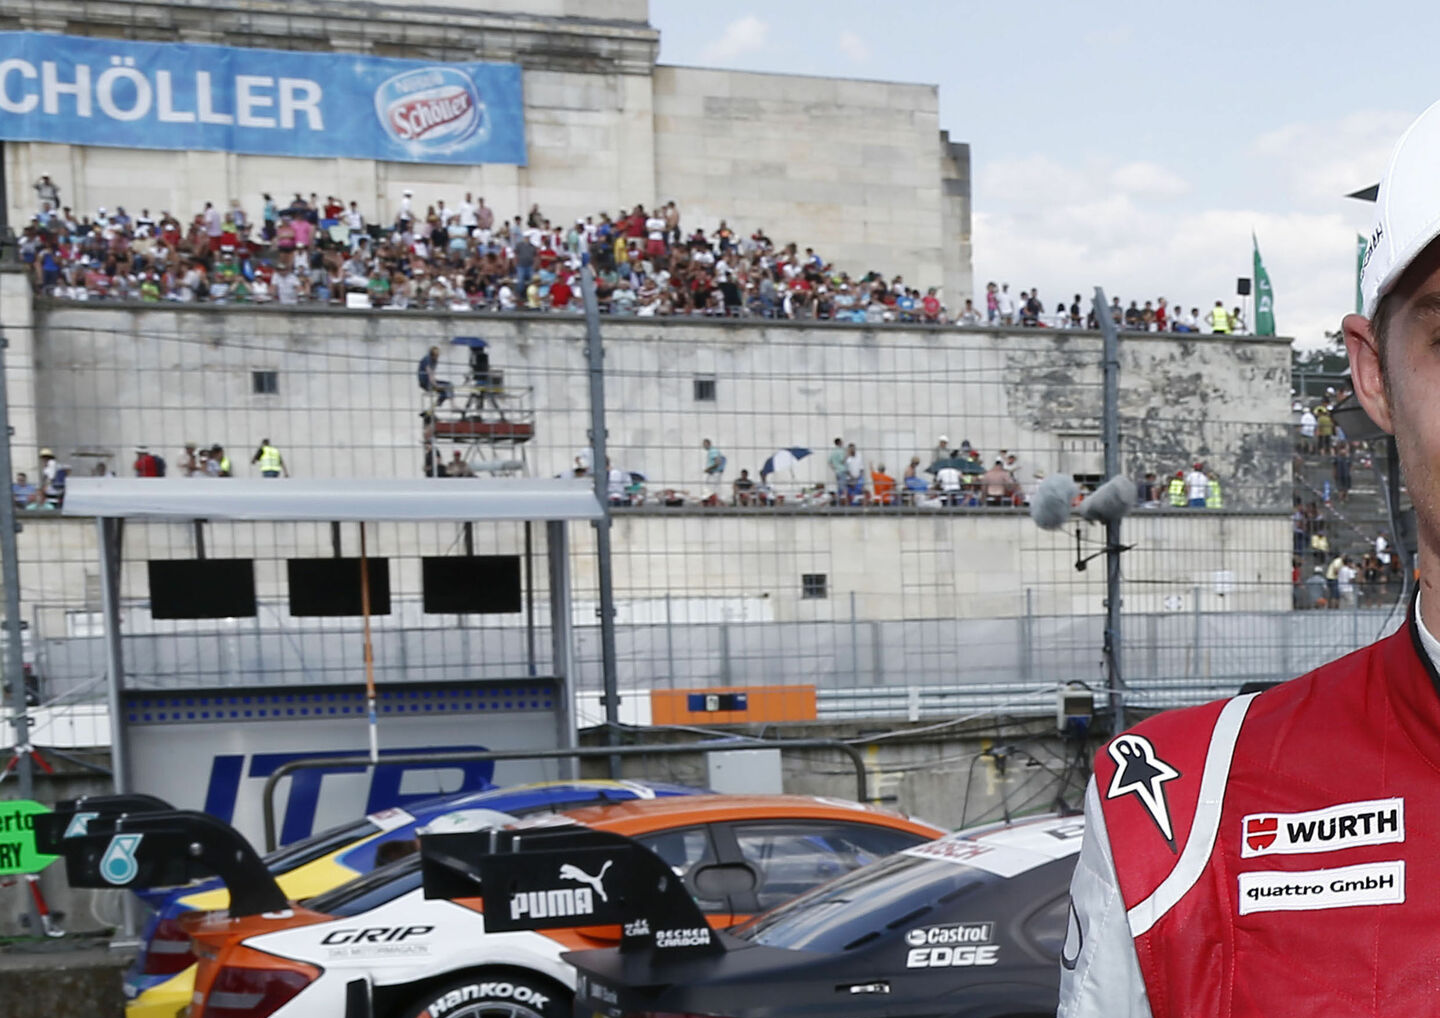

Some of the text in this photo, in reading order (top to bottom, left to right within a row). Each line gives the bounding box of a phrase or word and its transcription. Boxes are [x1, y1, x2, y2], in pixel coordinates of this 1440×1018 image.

[1247, 874, 1394, 901] quattro GmbH
[510, 887, 594, 920] PUMA
[321, 925, 435, 945] GRIP
[927, 924, 988, 944] Castrol
[906, 945, 1000, 968] EDGE
